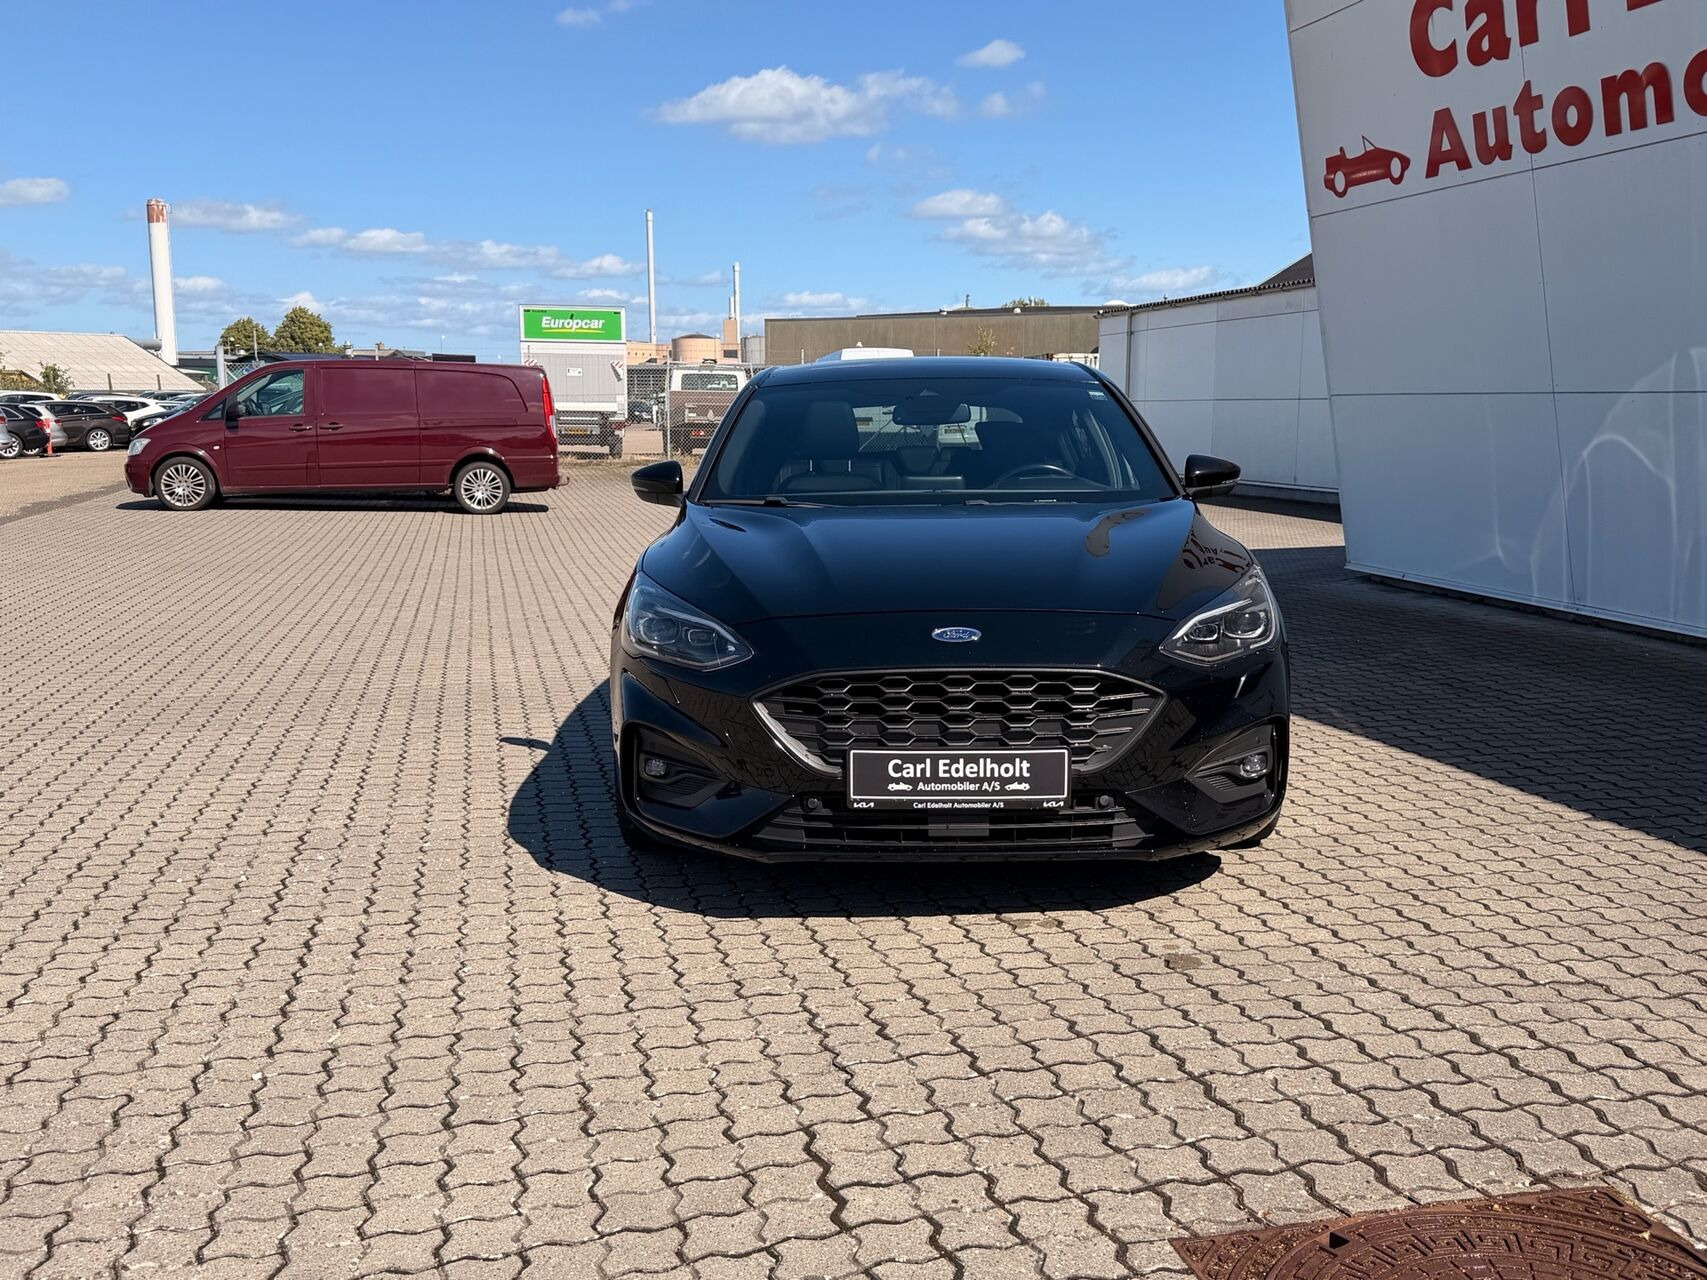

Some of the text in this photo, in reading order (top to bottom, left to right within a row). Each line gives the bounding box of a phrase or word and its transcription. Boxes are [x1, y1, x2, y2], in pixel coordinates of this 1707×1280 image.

[541, 313, 605, 332] Europcar
[887, 758, 1031, 778] Carl Edelholt
[916, 781, 1001, 792] Automobiler A/S
